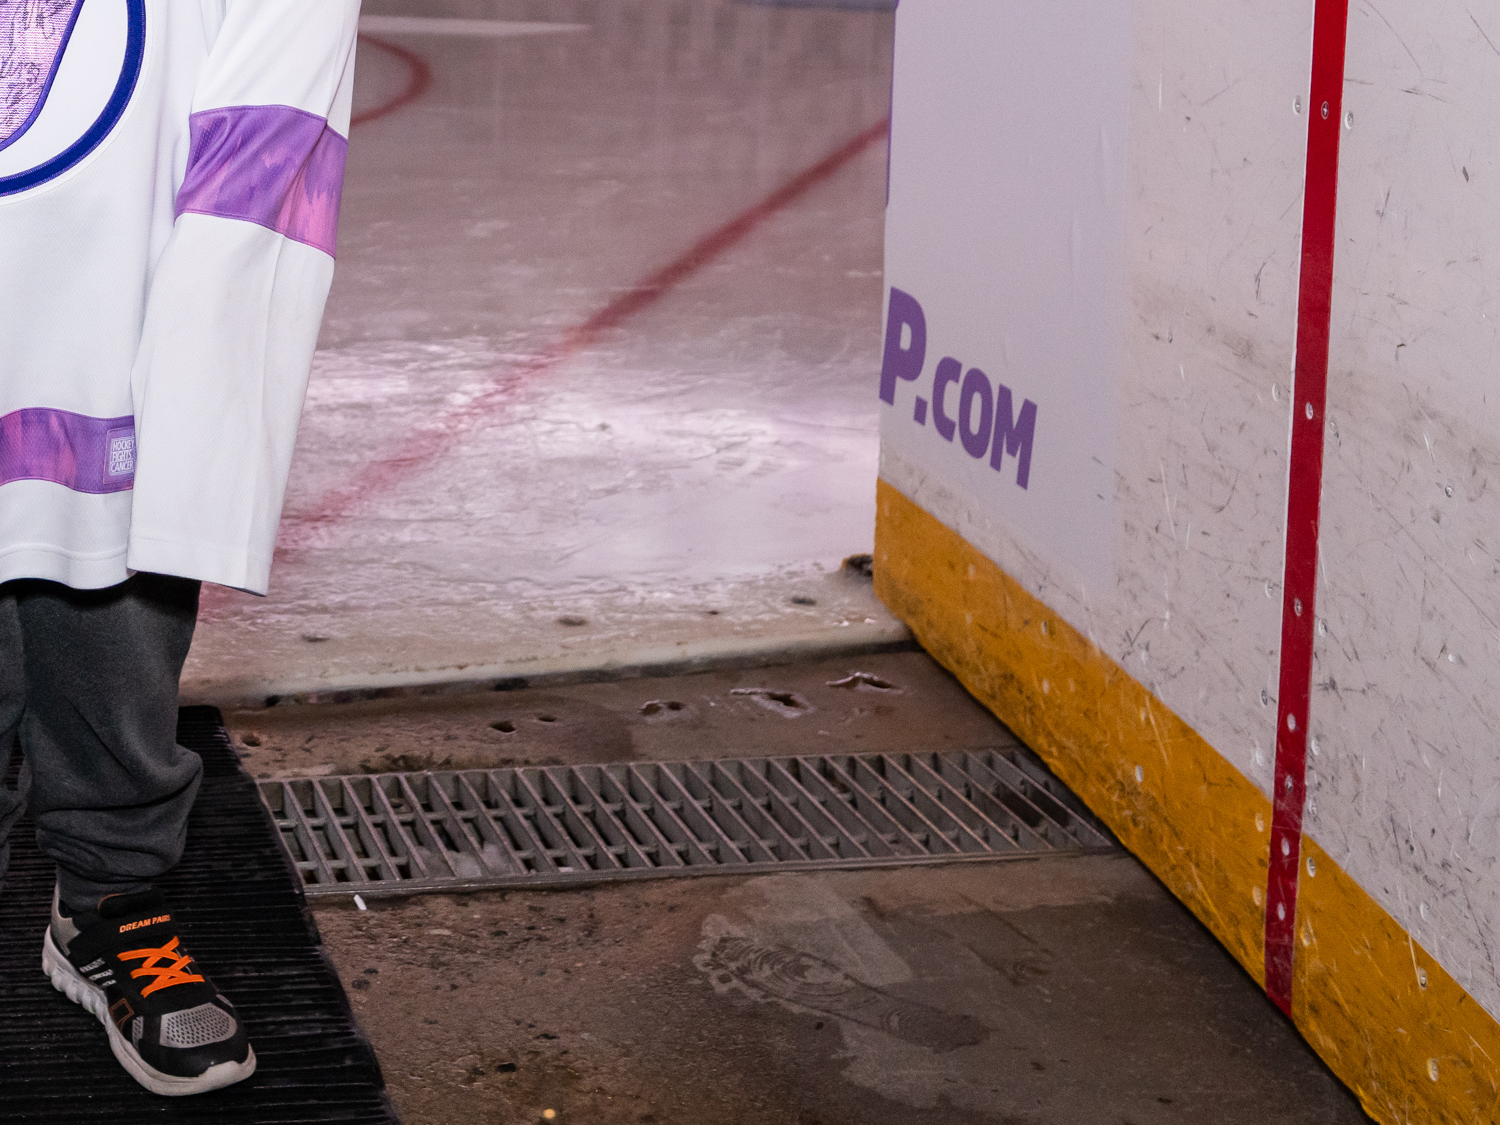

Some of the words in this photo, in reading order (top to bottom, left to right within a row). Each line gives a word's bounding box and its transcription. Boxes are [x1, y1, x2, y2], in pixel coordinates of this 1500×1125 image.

[113, 439, 135, 451] HOCKEY
[112, 450, 132, 462] FIGHTS
[110, 460, 134, 473] CANCER
[119, 918, 151, 933] DREAM
[151, 914, 171, 925] PAIRS
